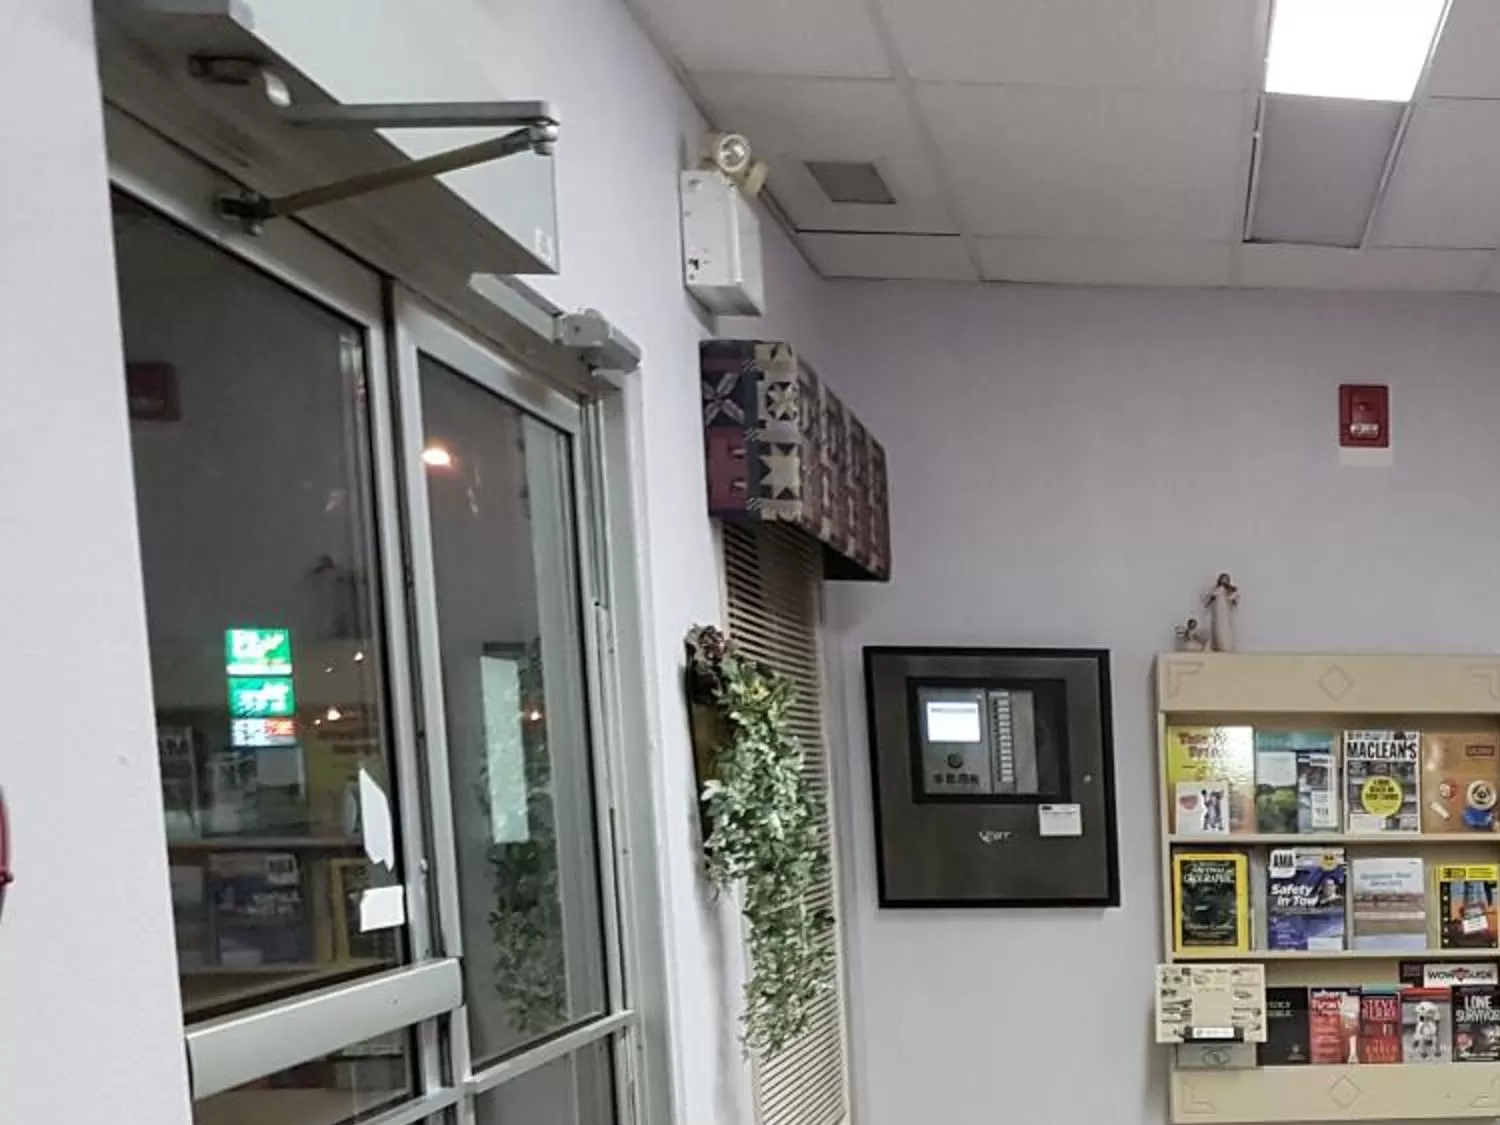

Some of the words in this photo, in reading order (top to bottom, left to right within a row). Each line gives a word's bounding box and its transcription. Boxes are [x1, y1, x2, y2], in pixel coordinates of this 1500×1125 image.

[1347, 740, 1417, 759] MACLEAN'S
[1271, 883, 1313, 897] Safety
[1464, 995, 1492, 1010] LONE
[1455, 1008, 1500, 1022] SURVIVOR
